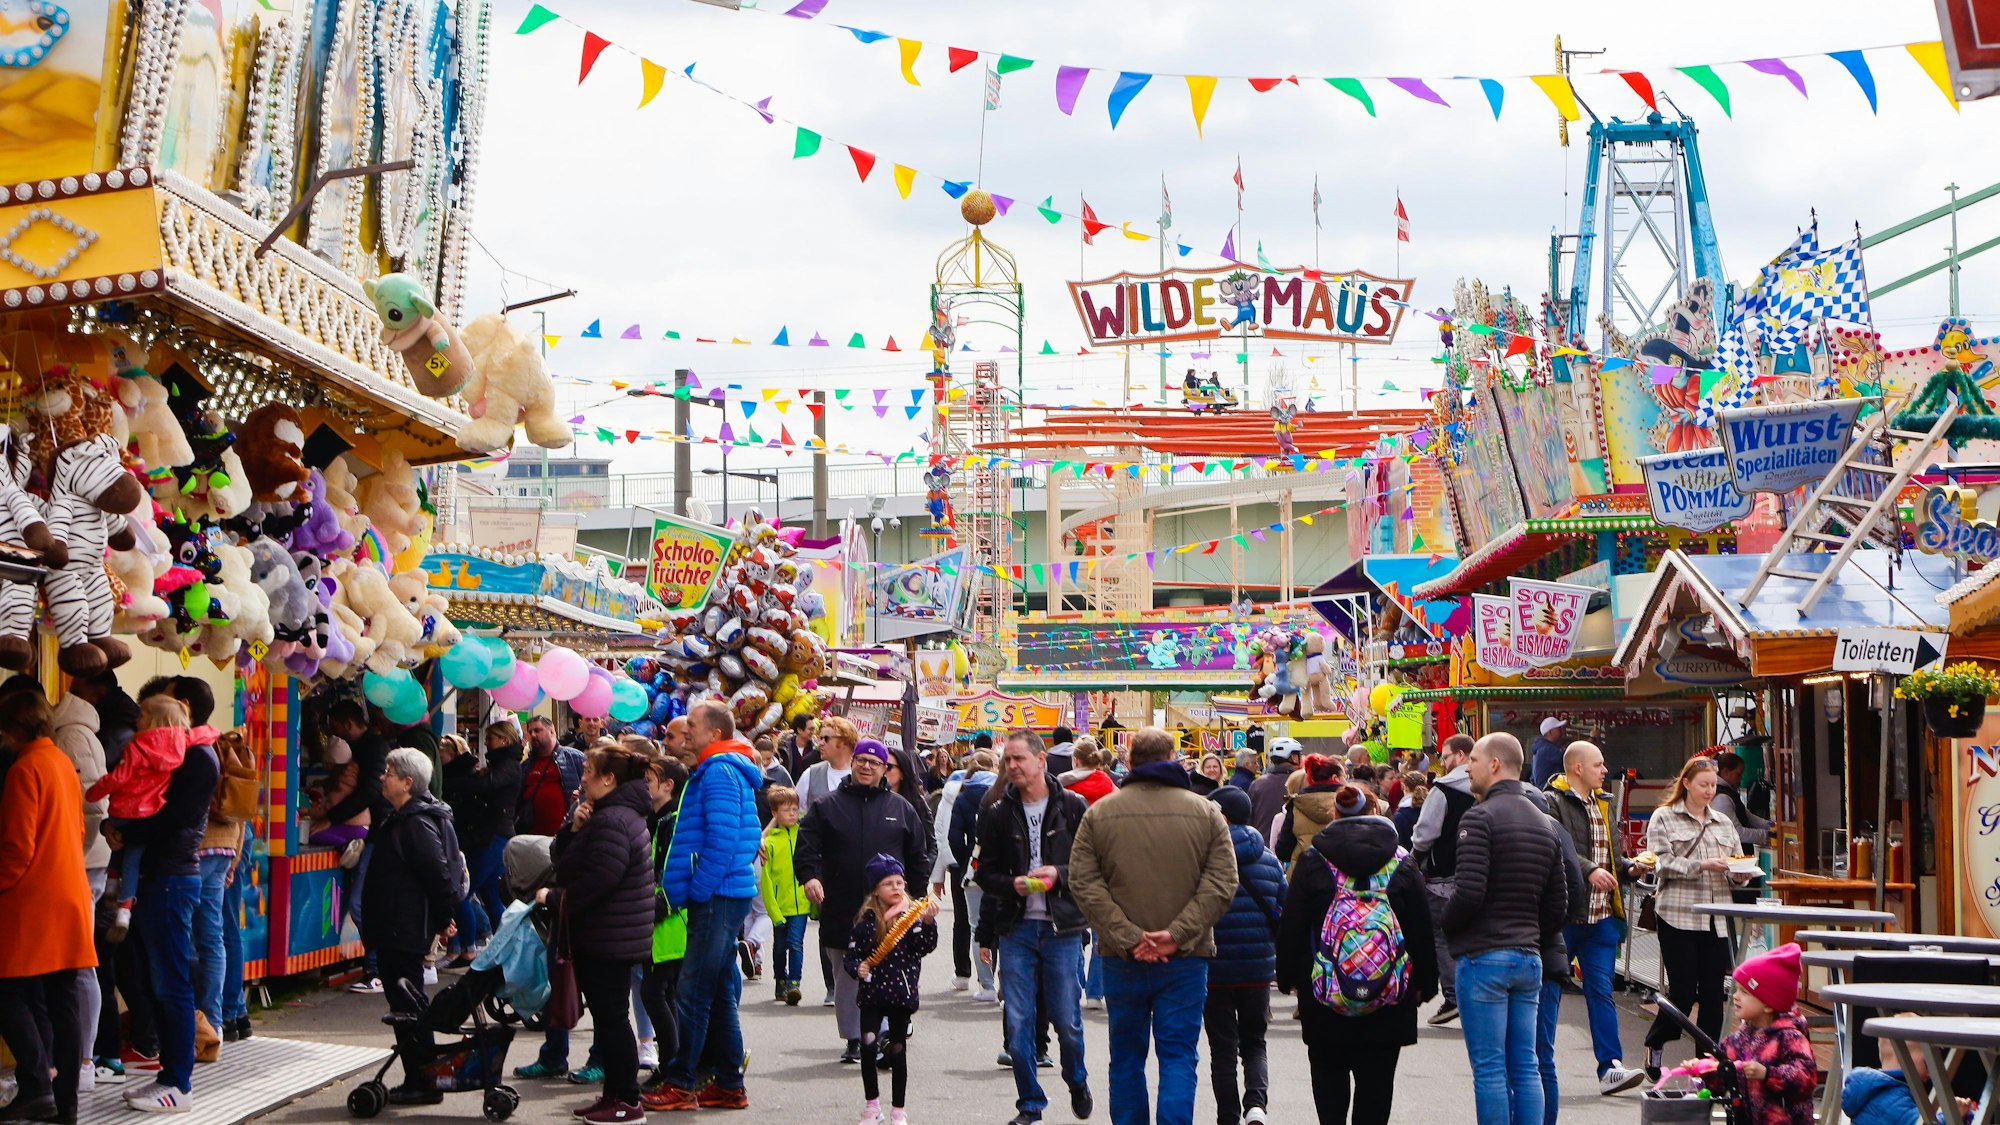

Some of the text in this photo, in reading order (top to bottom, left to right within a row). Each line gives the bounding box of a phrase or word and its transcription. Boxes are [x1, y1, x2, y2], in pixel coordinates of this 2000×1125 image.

[1081, 276, 1399, 338] WILDE MAUS
[1730, 412, 1850, 454] Wurst-
[1653, 453, 1726, 470] Stea
[1736, 446, 1837, 481] Spezialitäten
[1920, 490, 2000, 561] Stea
[653, 538, 720, 566] Schoko-
[653, 562, 712, 586] früchte
[1517, 588, 1583, 609] SOFT
[1516, 634, 1569, 658] EISMOHR
[1841, 638, 1915, 664] Toiletten
[964, 700, 1037, 726] ASSE
[1201, 729, 1247, 750] WIR
